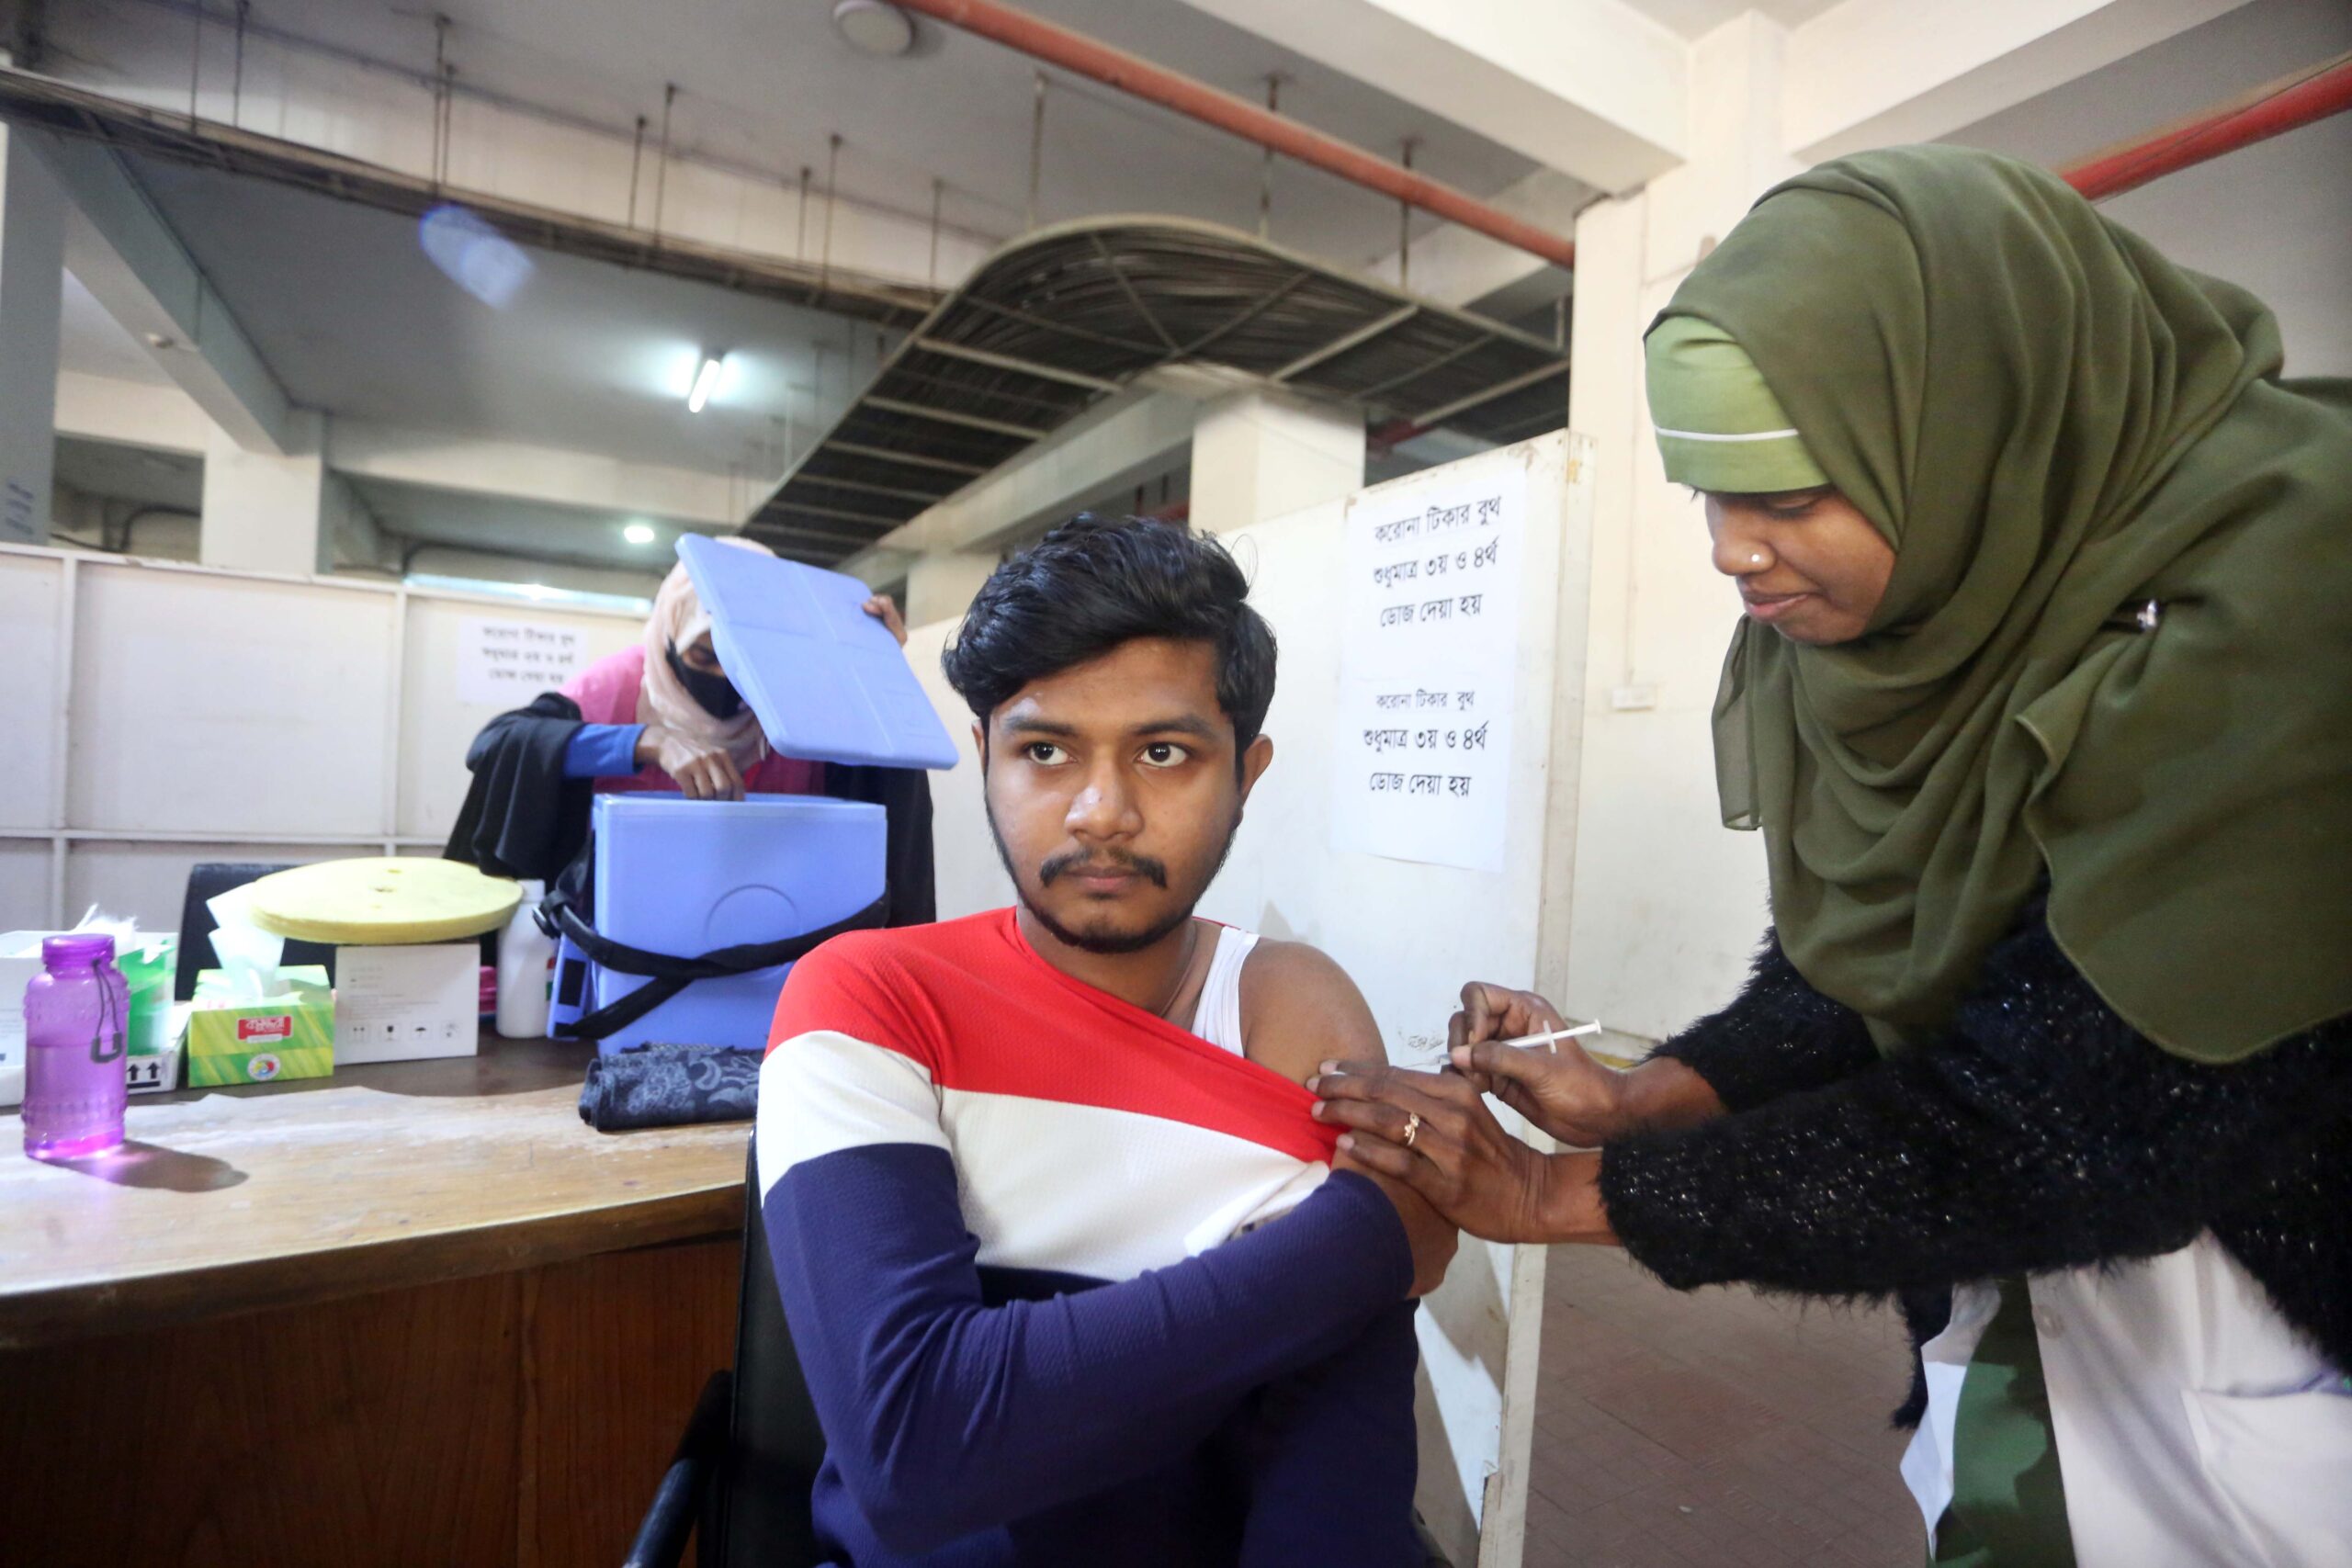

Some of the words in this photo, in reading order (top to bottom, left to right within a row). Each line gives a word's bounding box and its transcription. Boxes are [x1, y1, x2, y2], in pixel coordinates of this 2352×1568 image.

[1374, 517, 1420, 542] করোনা
[1427, 504, 1471, 533] টিকার
[1456, 552, 1467, 570] ও
[1460, 593, 1483, 616] হয়
[1416, 688, 1448, 708] টিকার
[1445, 730, 1457, 749] ও
[1448, 775, 1472, 797] হয়
